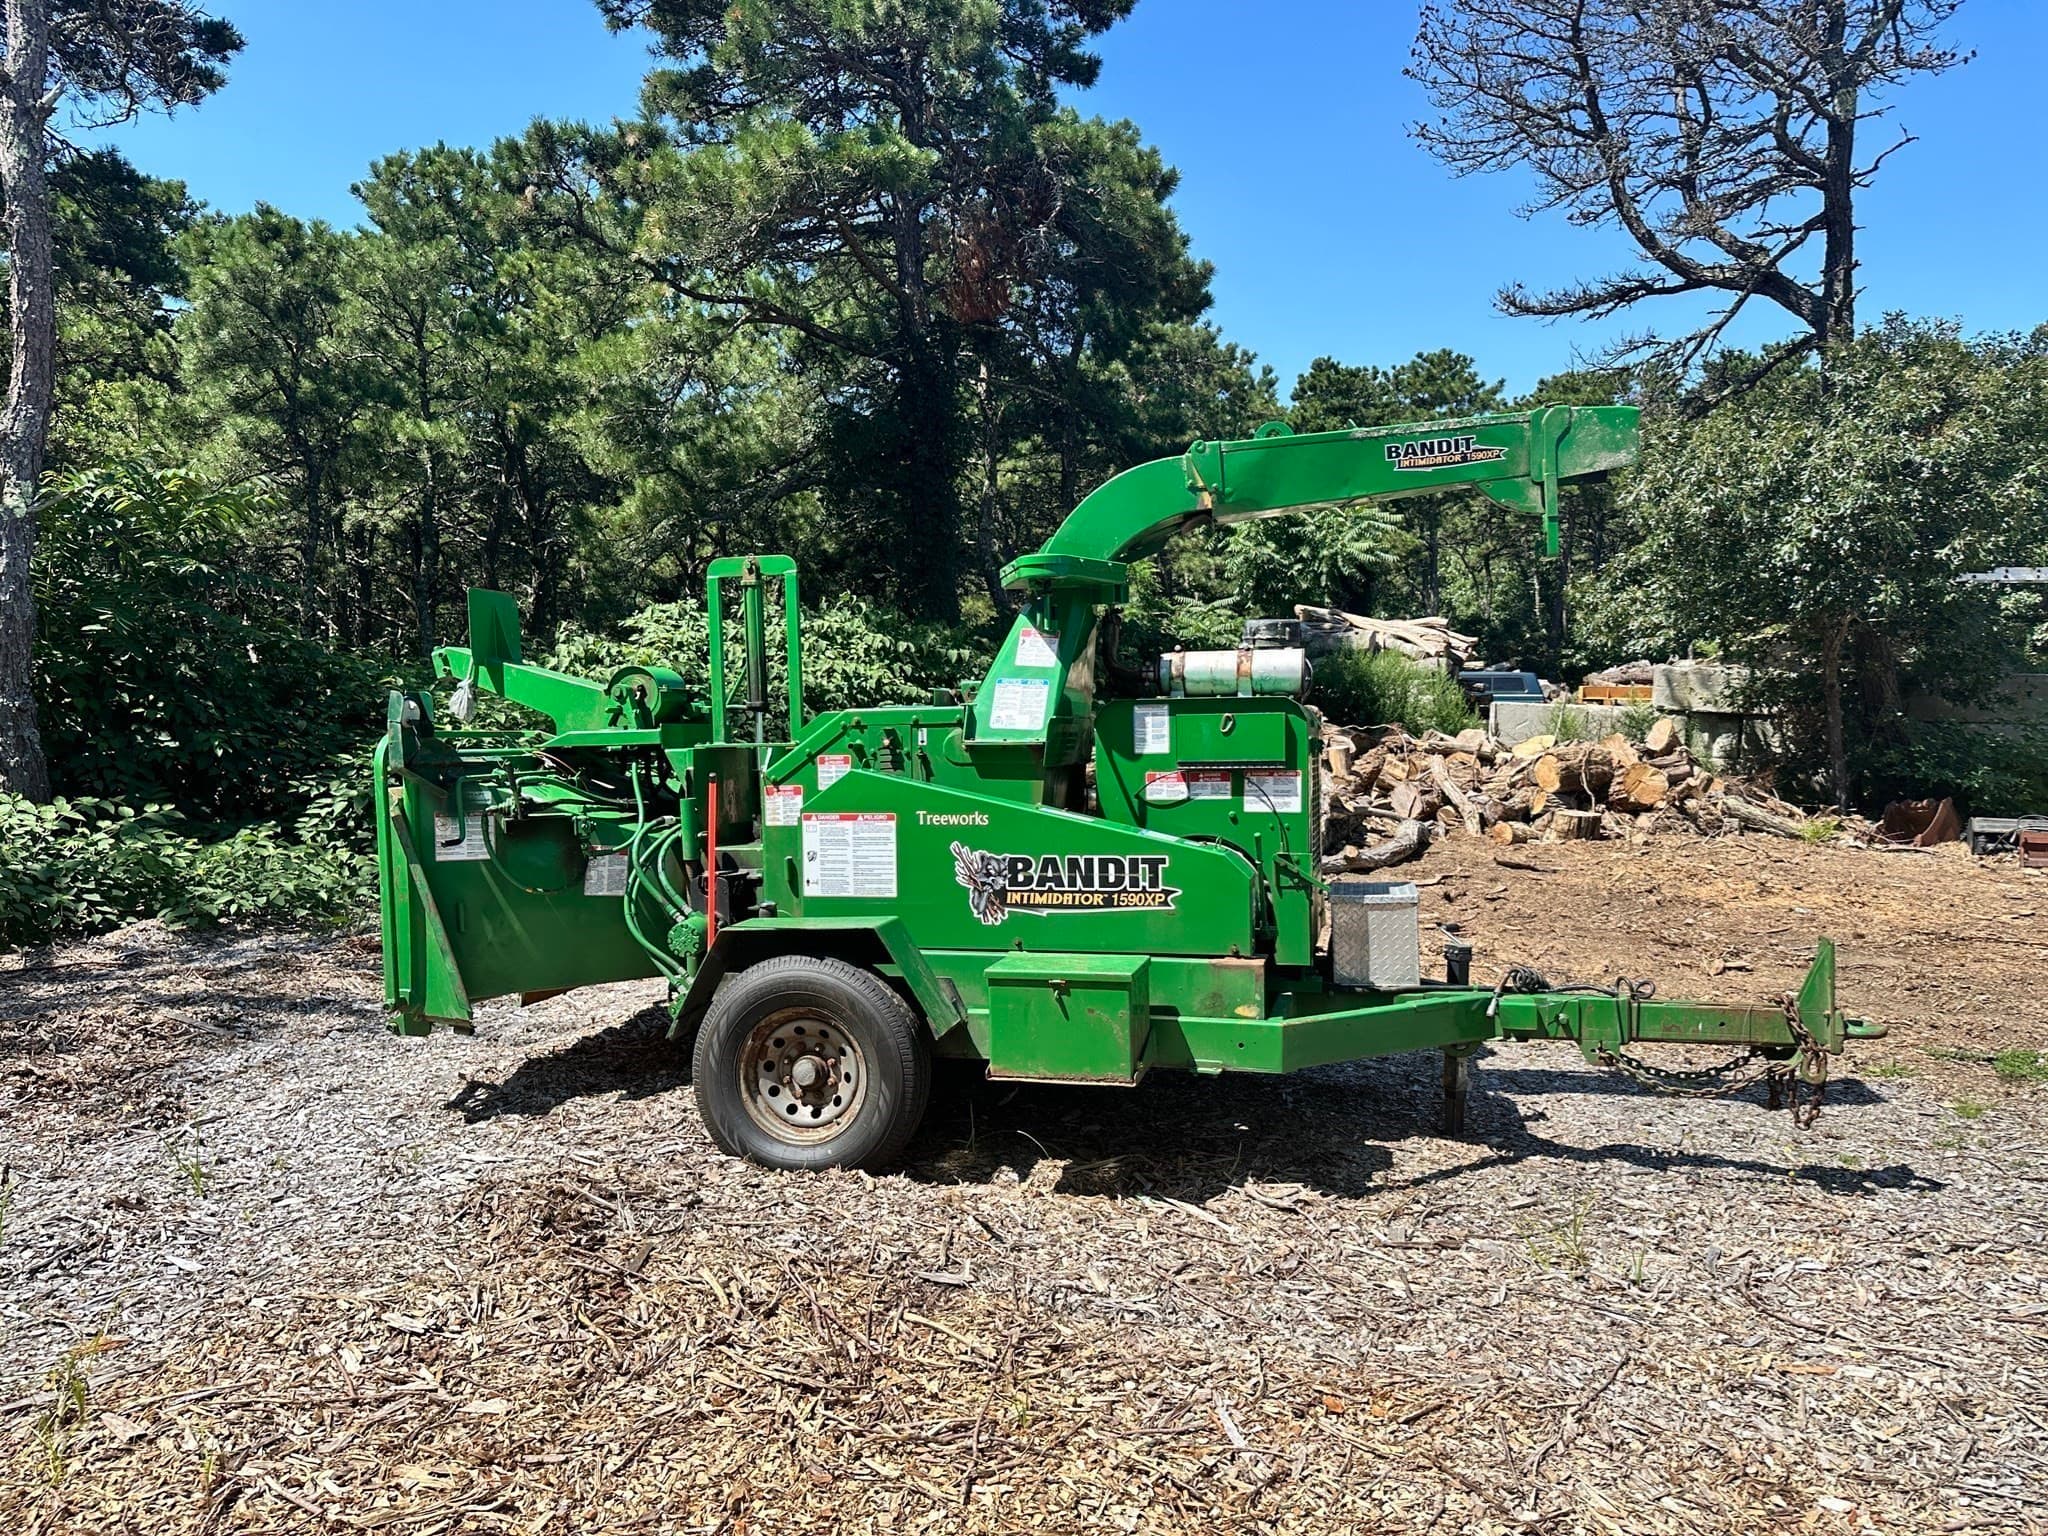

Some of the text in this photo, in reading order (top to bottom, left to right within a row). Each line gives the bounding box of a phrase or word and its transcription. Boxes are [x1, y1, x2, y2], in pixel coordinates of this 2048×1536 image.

[1386, 436, 1475, 460] BANDIT
[1400, 450, 1500, 467] INTIMIDATOR 1590XP
[916, 810, 989, 826] Treeworks
[1007, 856, 1167, 890] BANDIT
[1006, 892, 1166, 906] INTIMIDATOR 1590XP
